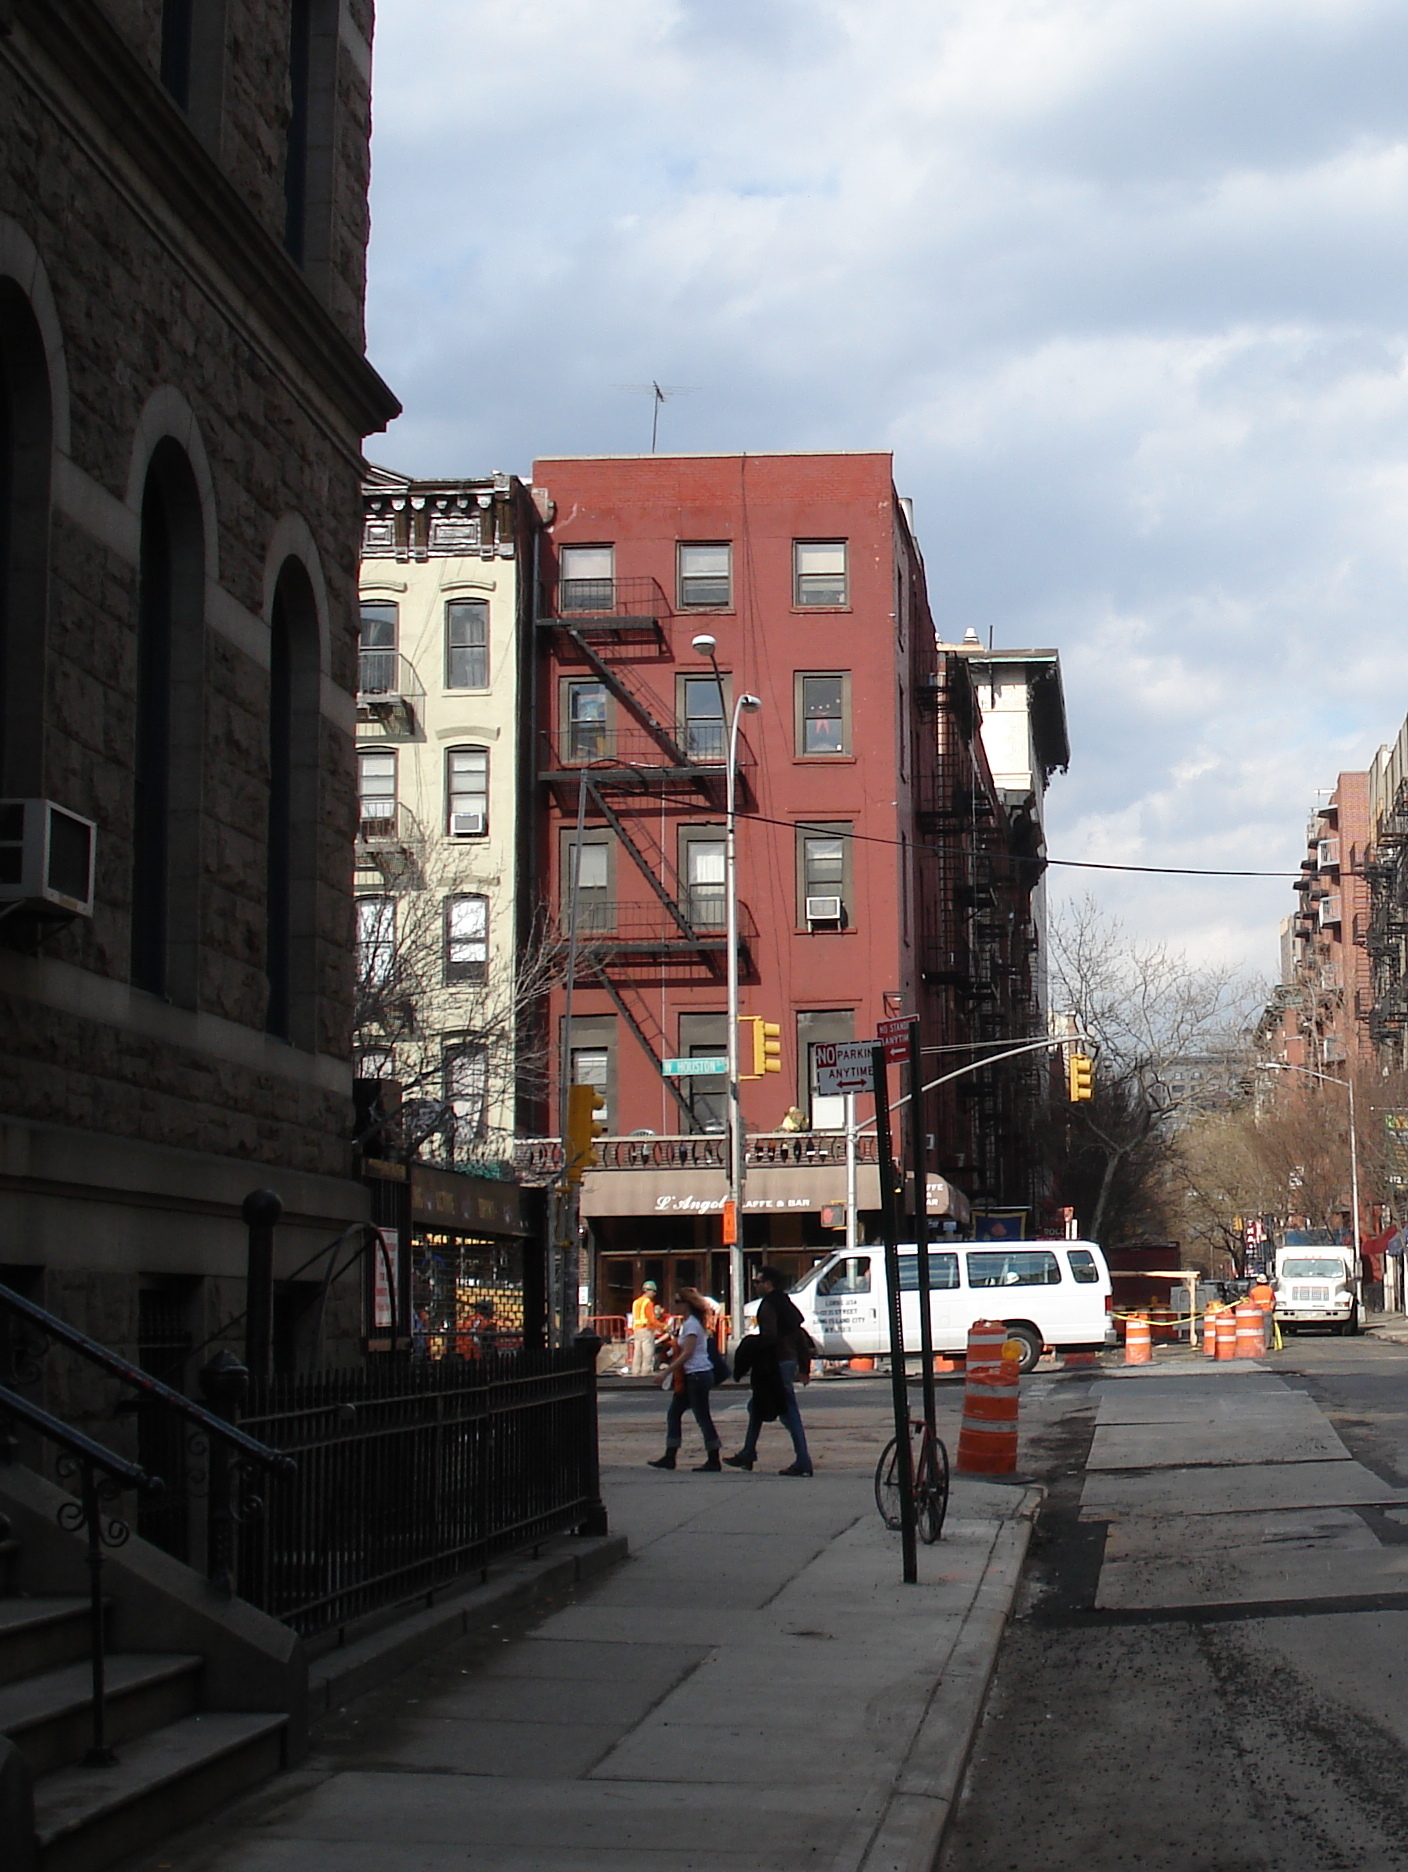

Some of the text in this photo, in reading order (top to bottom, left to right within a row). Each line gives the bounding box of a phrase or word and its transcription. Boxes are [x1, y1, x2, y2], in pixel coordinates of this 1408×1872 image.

[817, 1045, 873, 1065] NO PARKIN
[664, 1060, 671, 1073] W
[677, 1060, 715, 1073] HOUSTON
[828, 1066, 874, 1079] ANYTIME
[926, 1183, 943, 1191] FFE
[655, 1195, 728, 1214] L'Angol
[788, 1199, 810, 1207] BAR
[926, 1198, 938, 1206] AR
